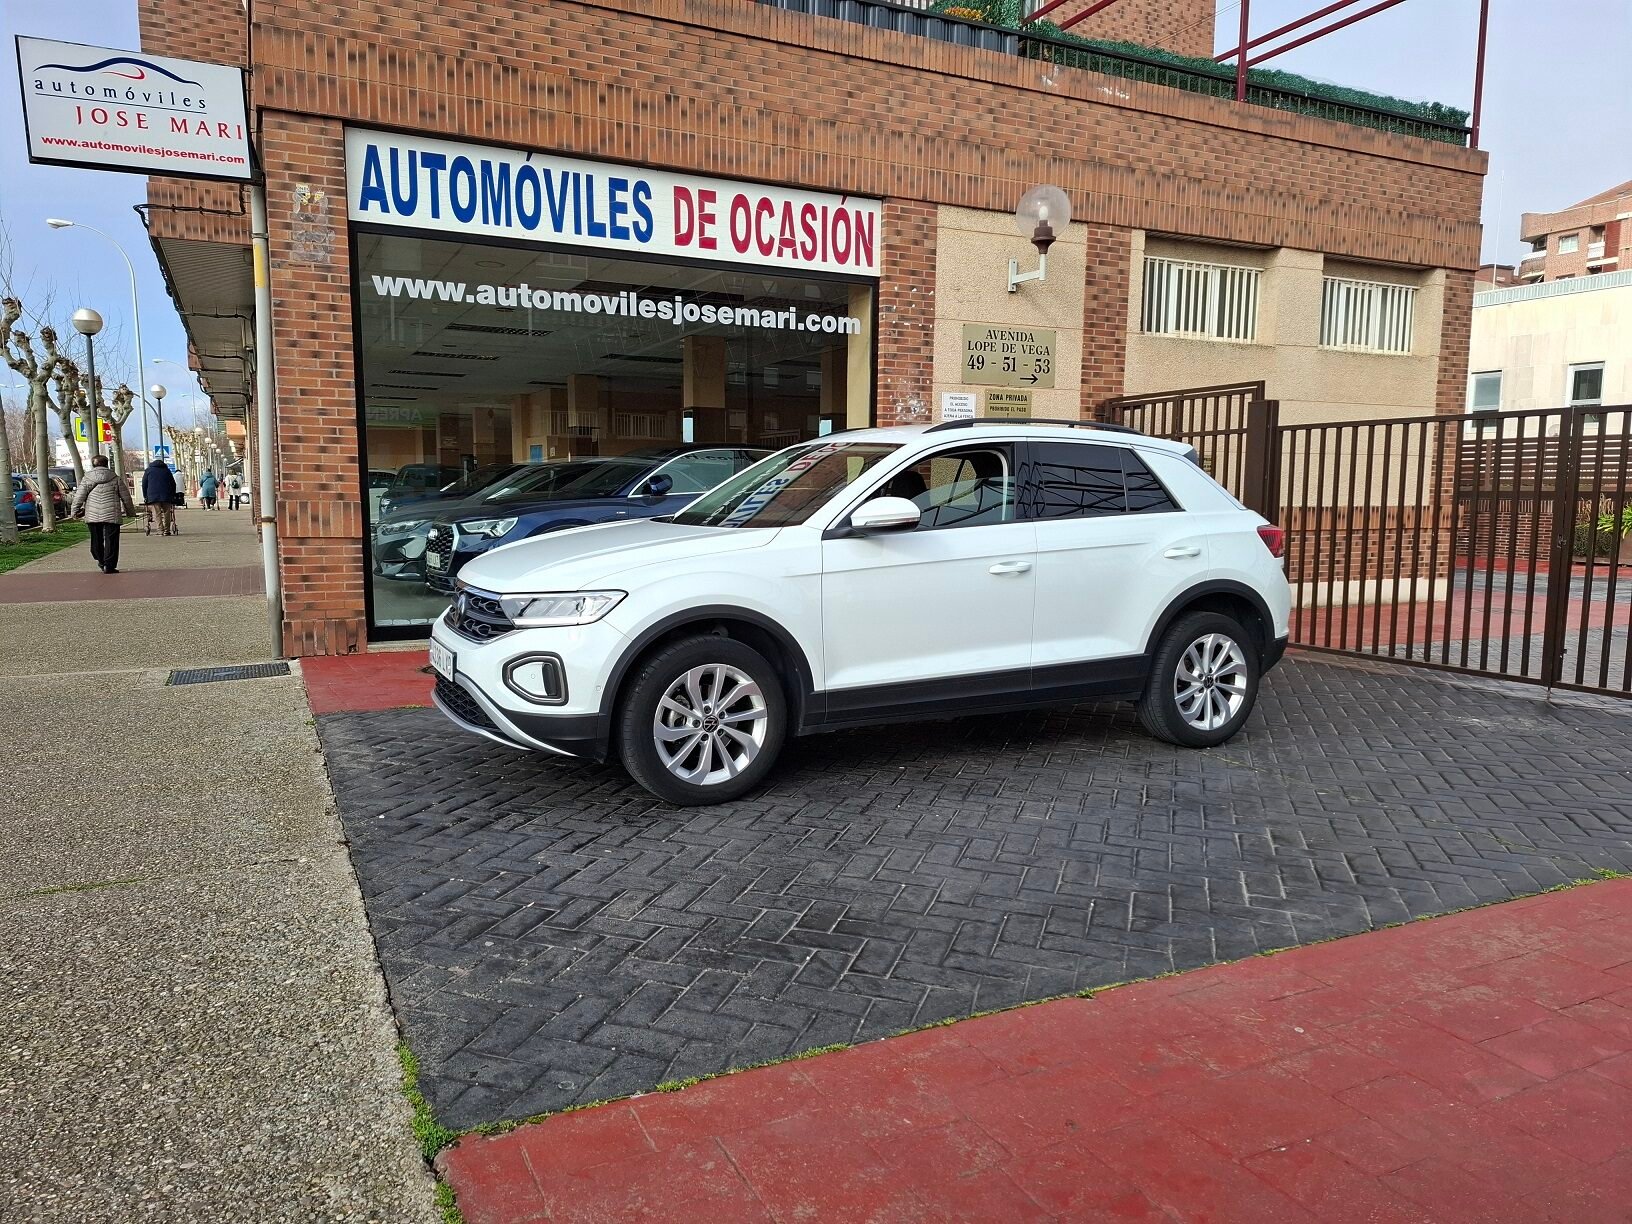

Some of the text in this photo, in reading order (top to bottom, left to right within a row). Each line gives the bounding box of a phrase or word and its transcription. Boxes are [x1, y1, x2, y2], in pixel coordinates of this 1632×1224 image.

[34, 78, 207, 109] automóviles
[75, 106, 243, 140] JOSE MARI
[41, 136, 245, 164] www.automovilesjosemari.com
[359, 143, 875, 268] AUTOMÓVILES DE OCASIÓN
[372, 274, 861, 335] www.automovilesjosemari.com
[967, 340, 1050, 356] LOPE DE VEGA
[985, 330, 1035, 342] AVENIDA
[967, 354, 985, 371] 49
[1002, 356, 1017, 372] 51
[1034, 358, 1051, 374] 53
[989, 393, 1028, 402] ZONA PRIVADA
